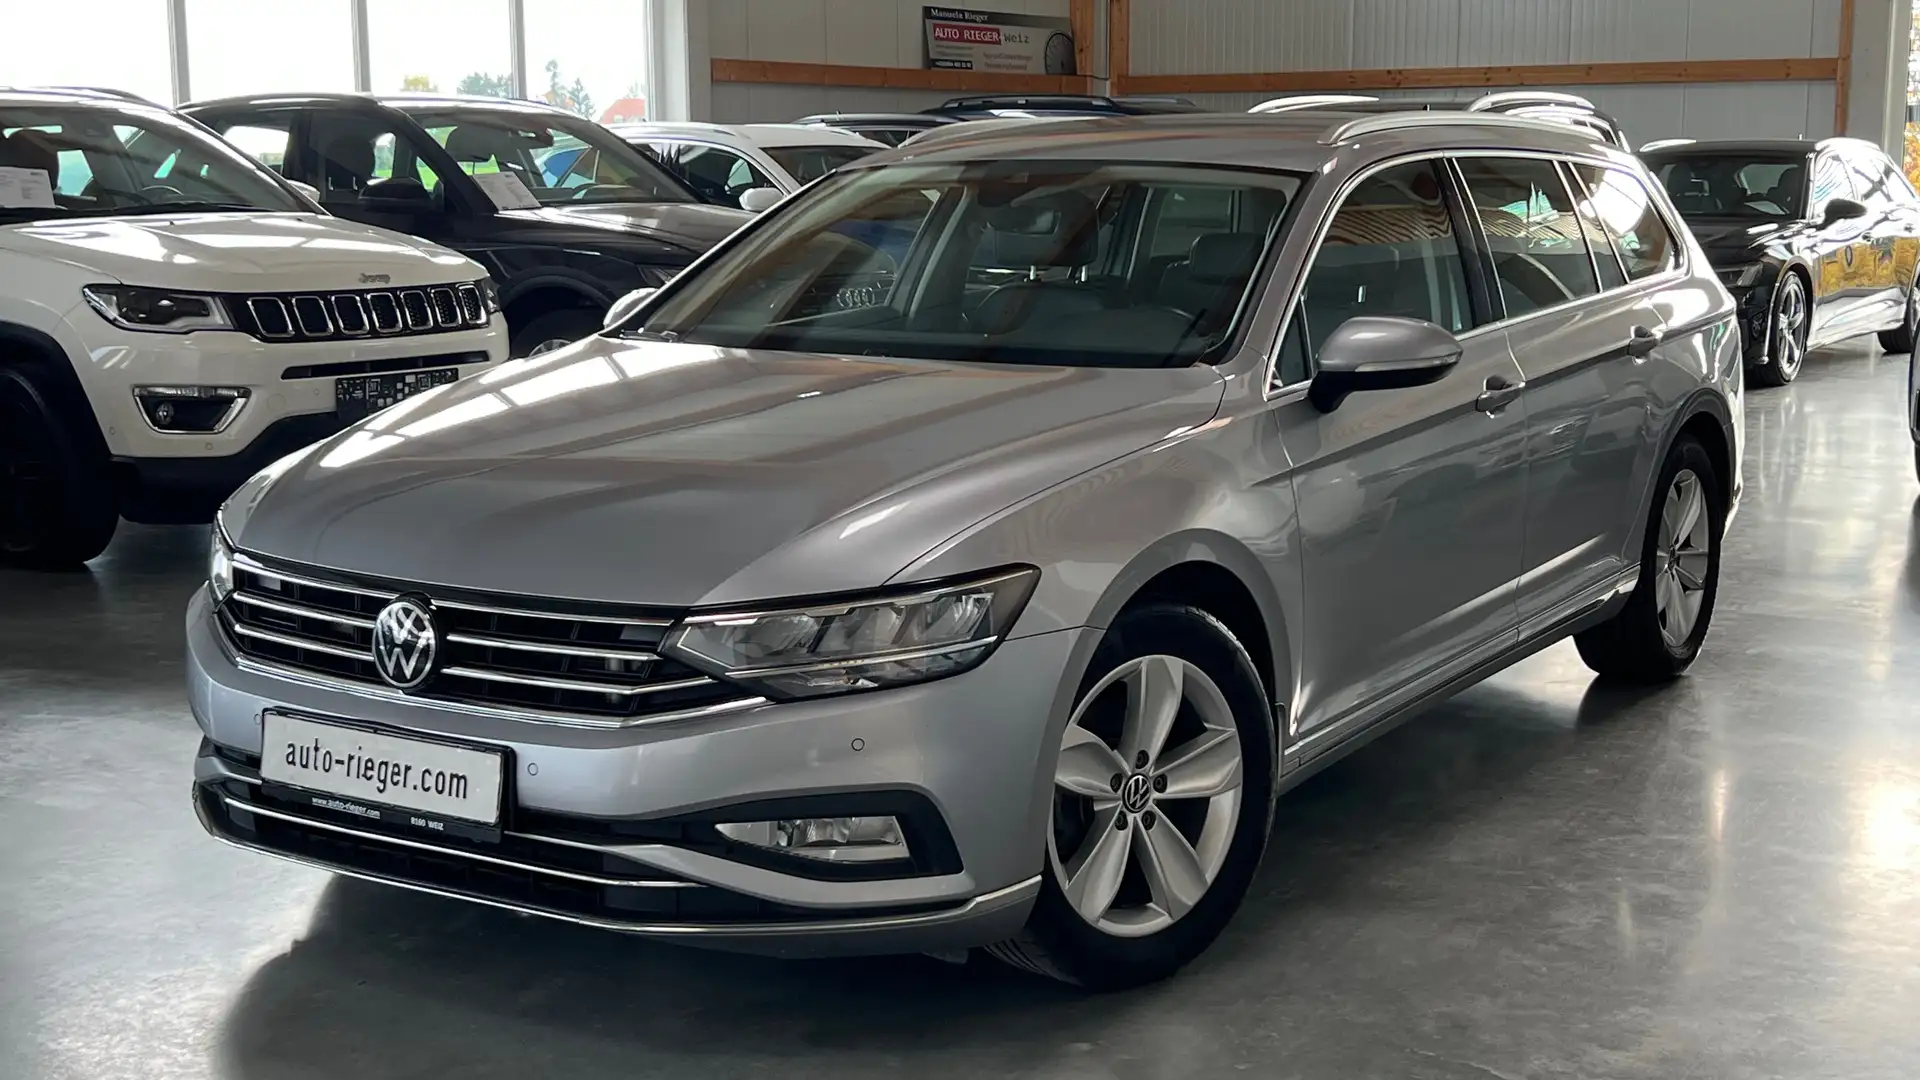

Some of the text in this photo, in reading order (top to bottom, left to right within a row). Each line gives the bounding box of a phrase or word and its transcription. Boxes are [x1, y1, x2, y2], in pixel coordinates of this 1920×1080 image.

[931, 8, 989, 23] Manuela Rieger
[935, 28, 960, 39] AUTO
[963, 30, 1000, 41] RIEGER
[286, 738, 467, 799] auto-rieger.com
[311, 797, 380, 819] www.auto-rieger.com
[428, 820, 444, 831] WEIZ
